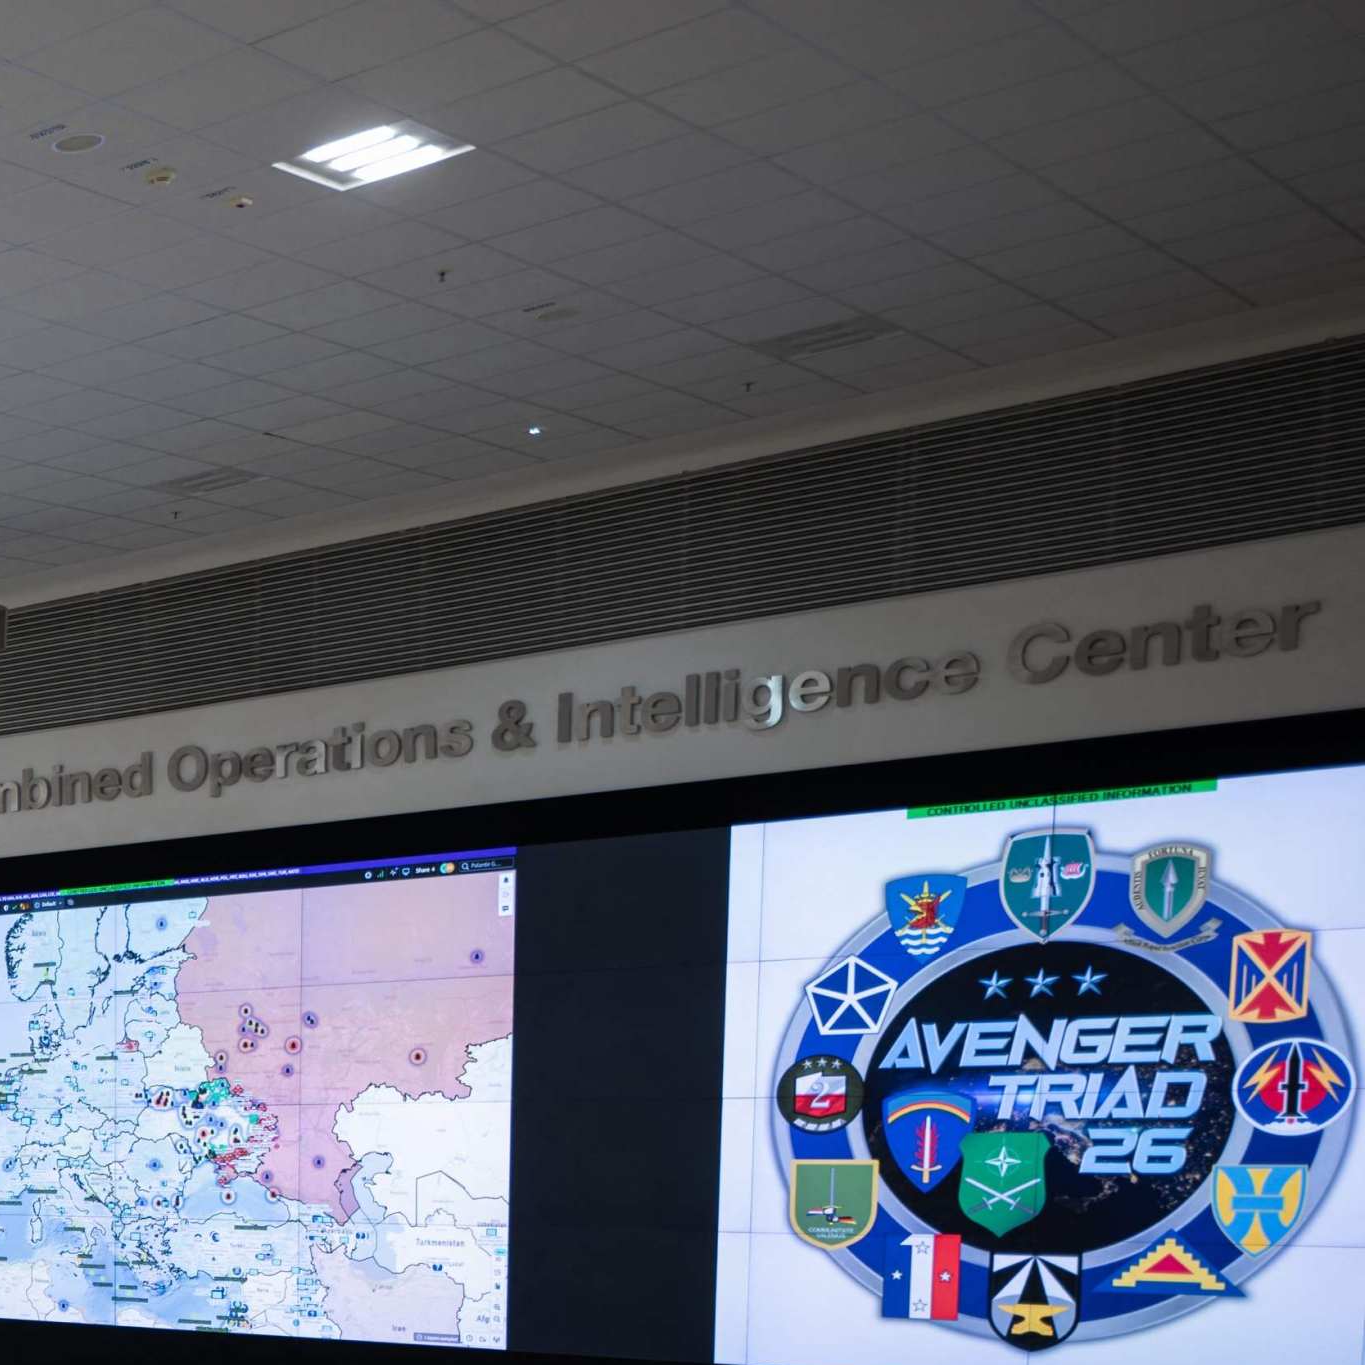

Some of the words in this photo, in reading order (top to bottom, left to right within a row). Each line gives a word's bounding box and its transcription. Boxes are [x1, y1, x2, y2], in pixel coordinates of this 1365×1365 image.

[166, 718, 476, 798] Operations
[490, 699, 537, 753] &
[556, 646, 981, 745] Intelligence
[1007, 600, 1322, 685] Center
[926, 801, 1006, 817] CONTROLLED
[1010, 792, 1099, 809] UNCLASSIFIED
[1103, 783, 1192, 800] INFORMATION
[878, 1012, 1223, 1075] AVENGER
[810, 1081, 830, 1109] 2
[988, 1064, 1208, 1121] TRIAD
[1078, 1126, 1195, 1175] 26
[415, 1237, 465, 1248] Turkmenistan
